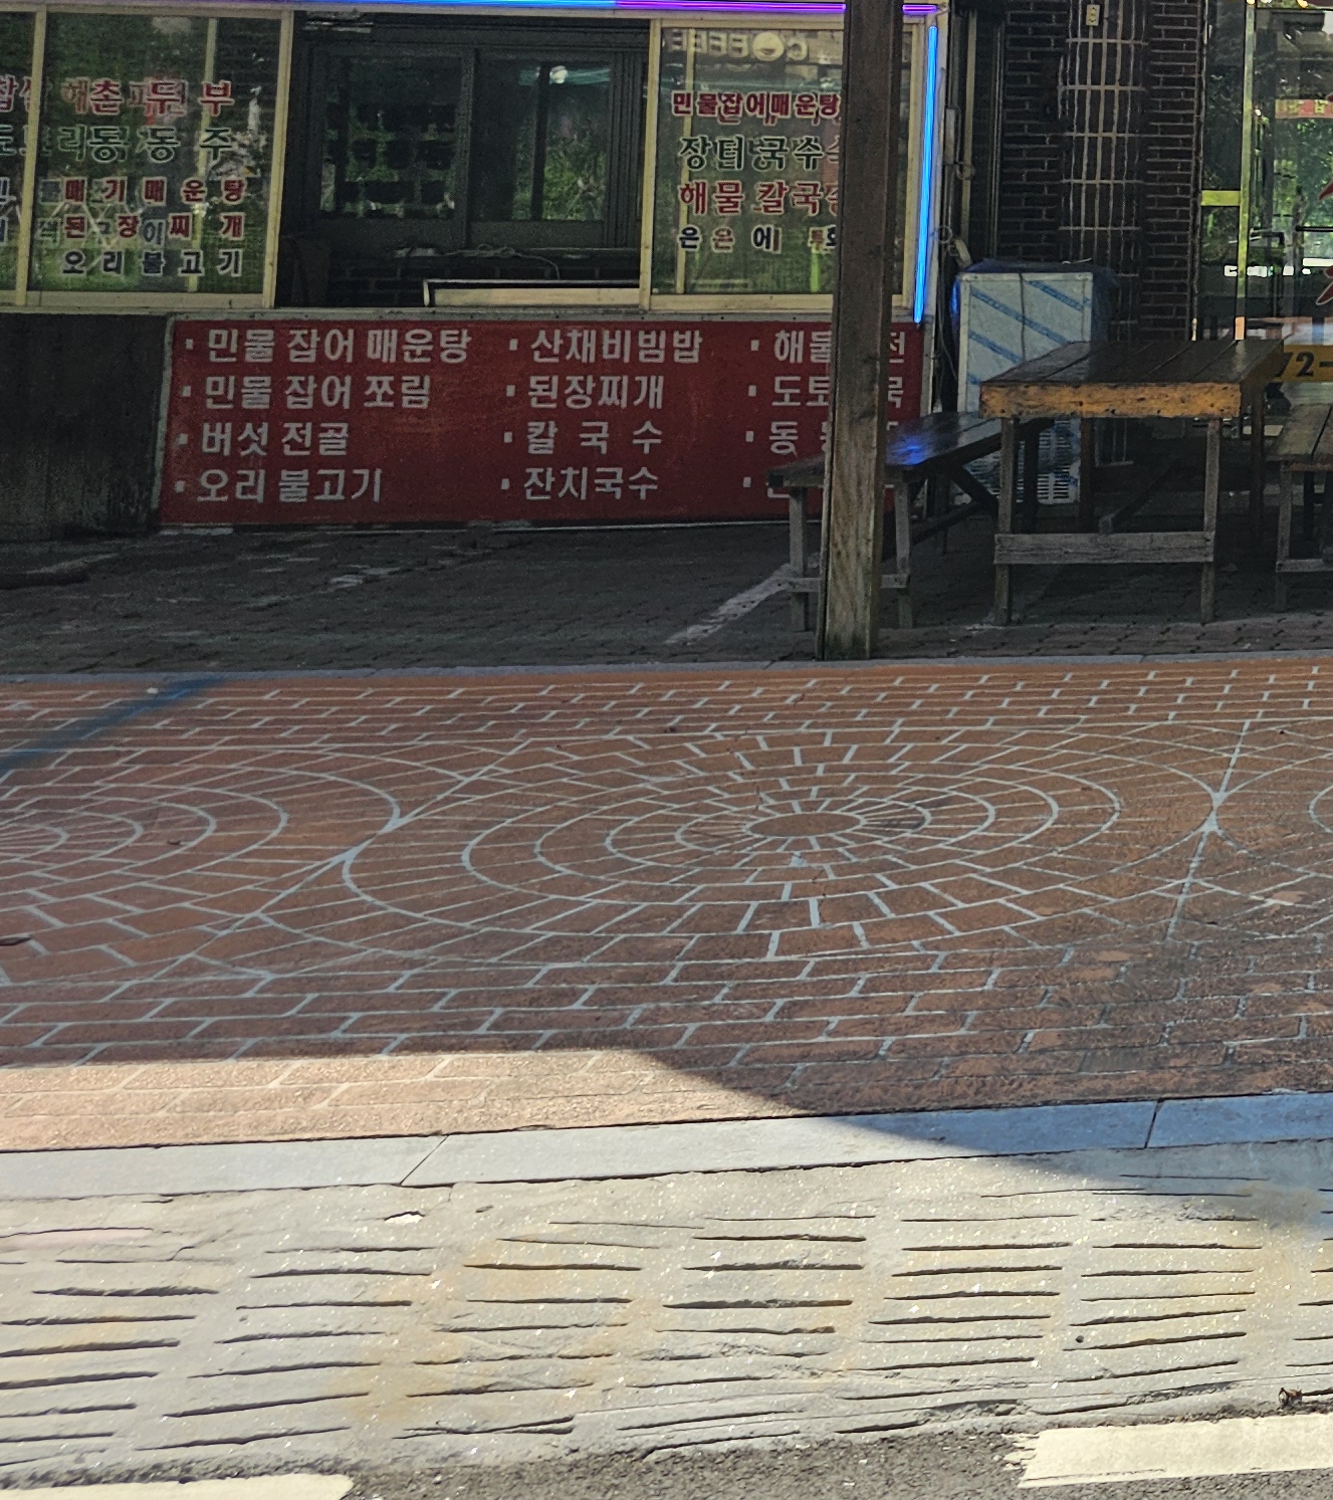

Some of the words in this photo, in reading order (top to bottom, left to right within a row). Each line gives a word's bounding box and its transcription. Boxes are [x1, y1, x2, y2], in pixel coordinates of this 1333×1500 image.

[89, 126, 234, 163] 동동주
[62, 248, 244, 277] 오리불고기
[207, 328, 276, 364] 민물
[286, 328, 354, 364] 잡어
[367, 328, 472, 365] 매운탕
[530, 328, 703, 364] 산채비빔밥
[204, 375, 272, 410] 민물
[284, 375, 351, 410] 잡어
[363, 375, 432, 410] 쪼림
[527, 374, 666, 410] 된장찌개
[201, 422, 269, 457] 버섯
[281, 422, 350, 456] 전골
[525, 420, 663, 455] 칼국수
[197, 468, 266, 503] 오리
[278, 468, 383, 503] 불고기
[523, 466, 660, 501] 잔치국수
